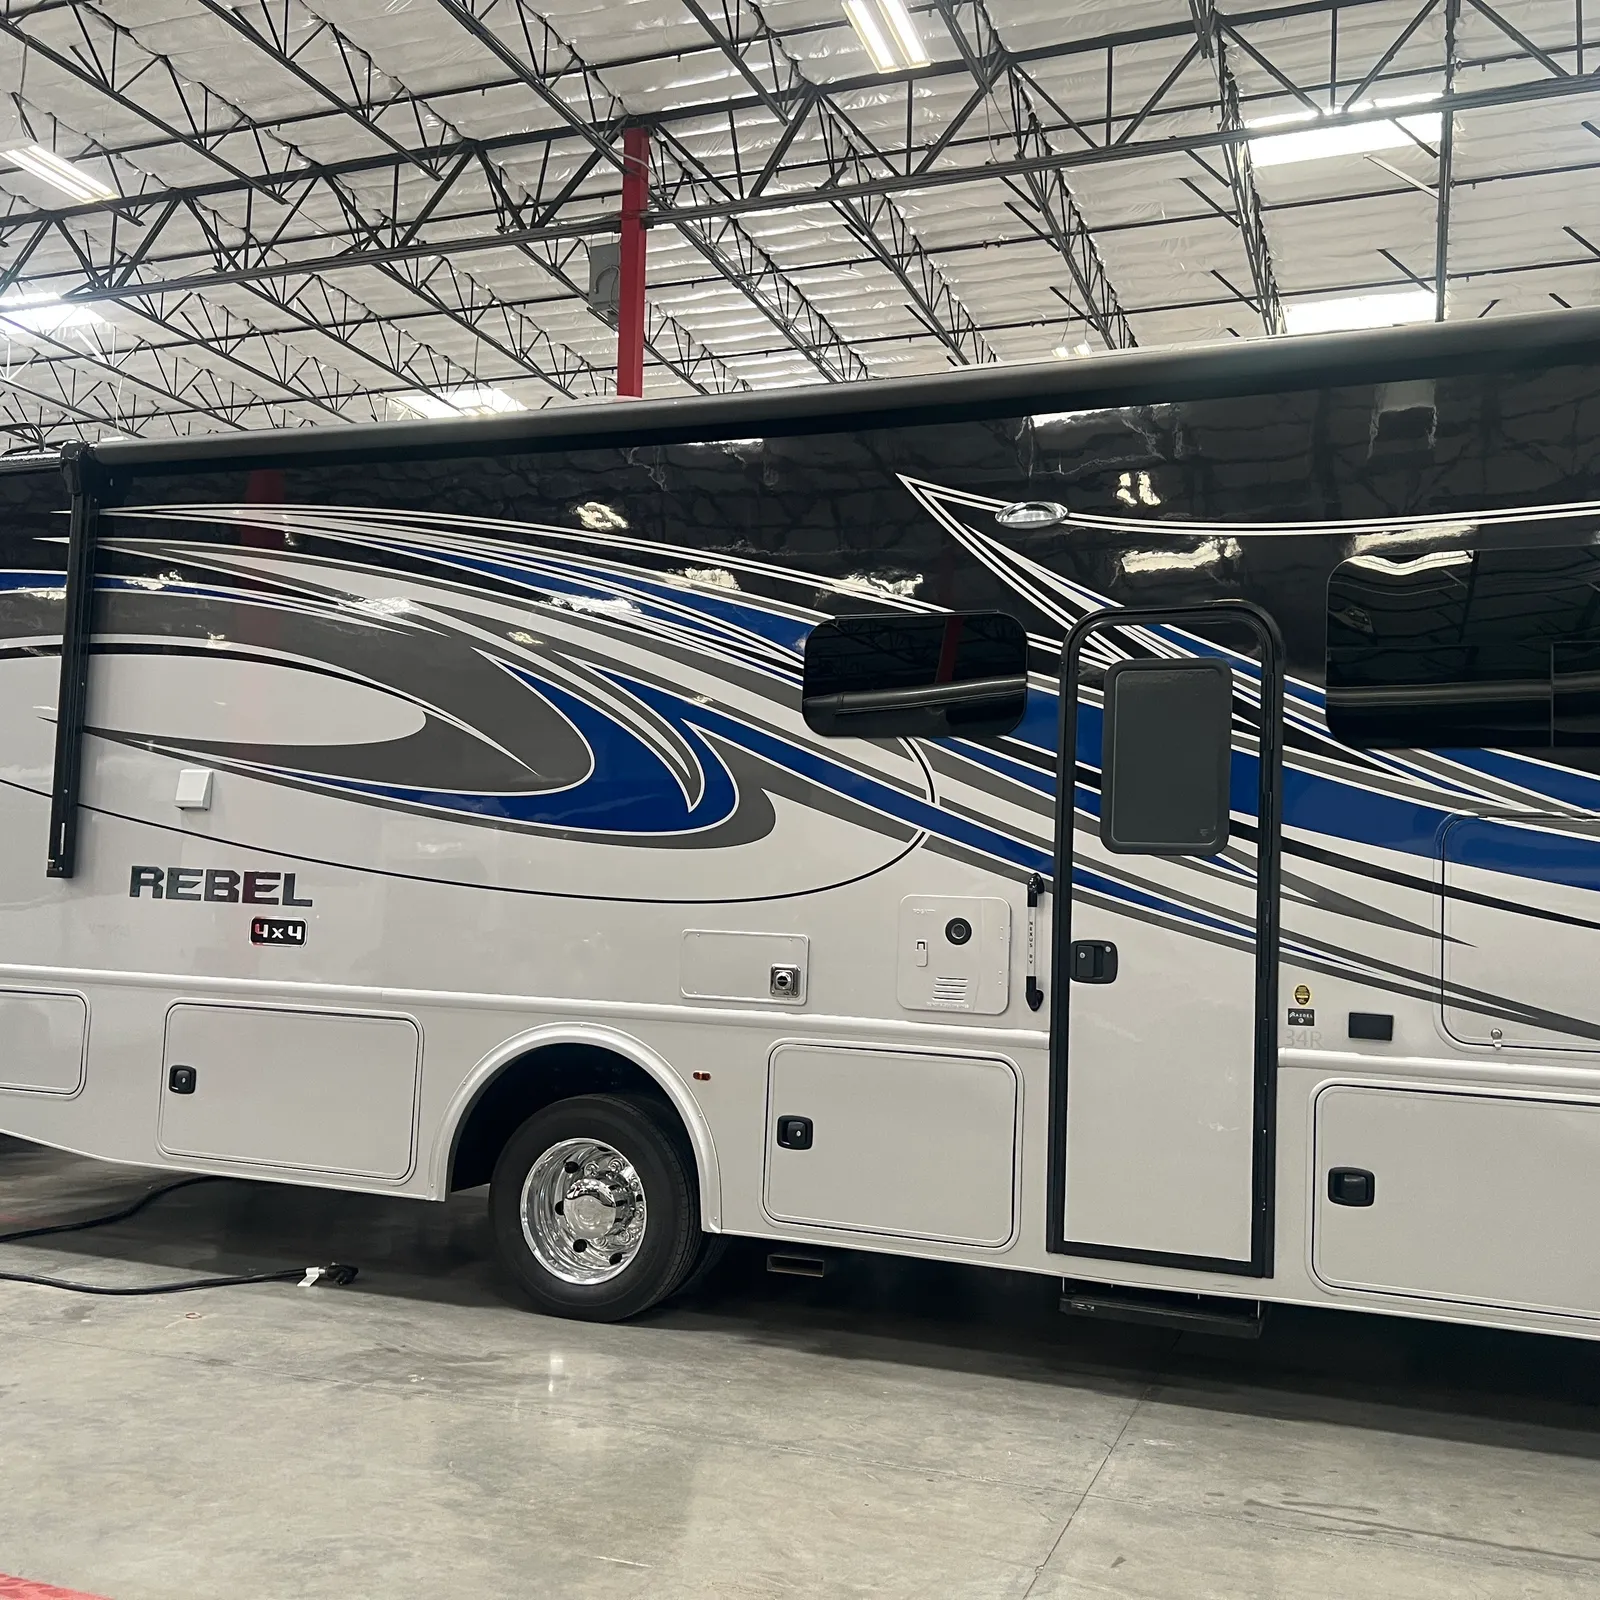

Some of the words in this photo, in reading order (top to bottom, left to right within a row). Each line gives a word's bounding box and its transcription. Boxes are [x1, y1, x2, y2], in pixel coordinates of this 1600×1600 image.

[129, 865, 313, 907] REBEL
[254, 923, 302, 940] 4x4
[1285, 1029, 1323, 1048] 34R
